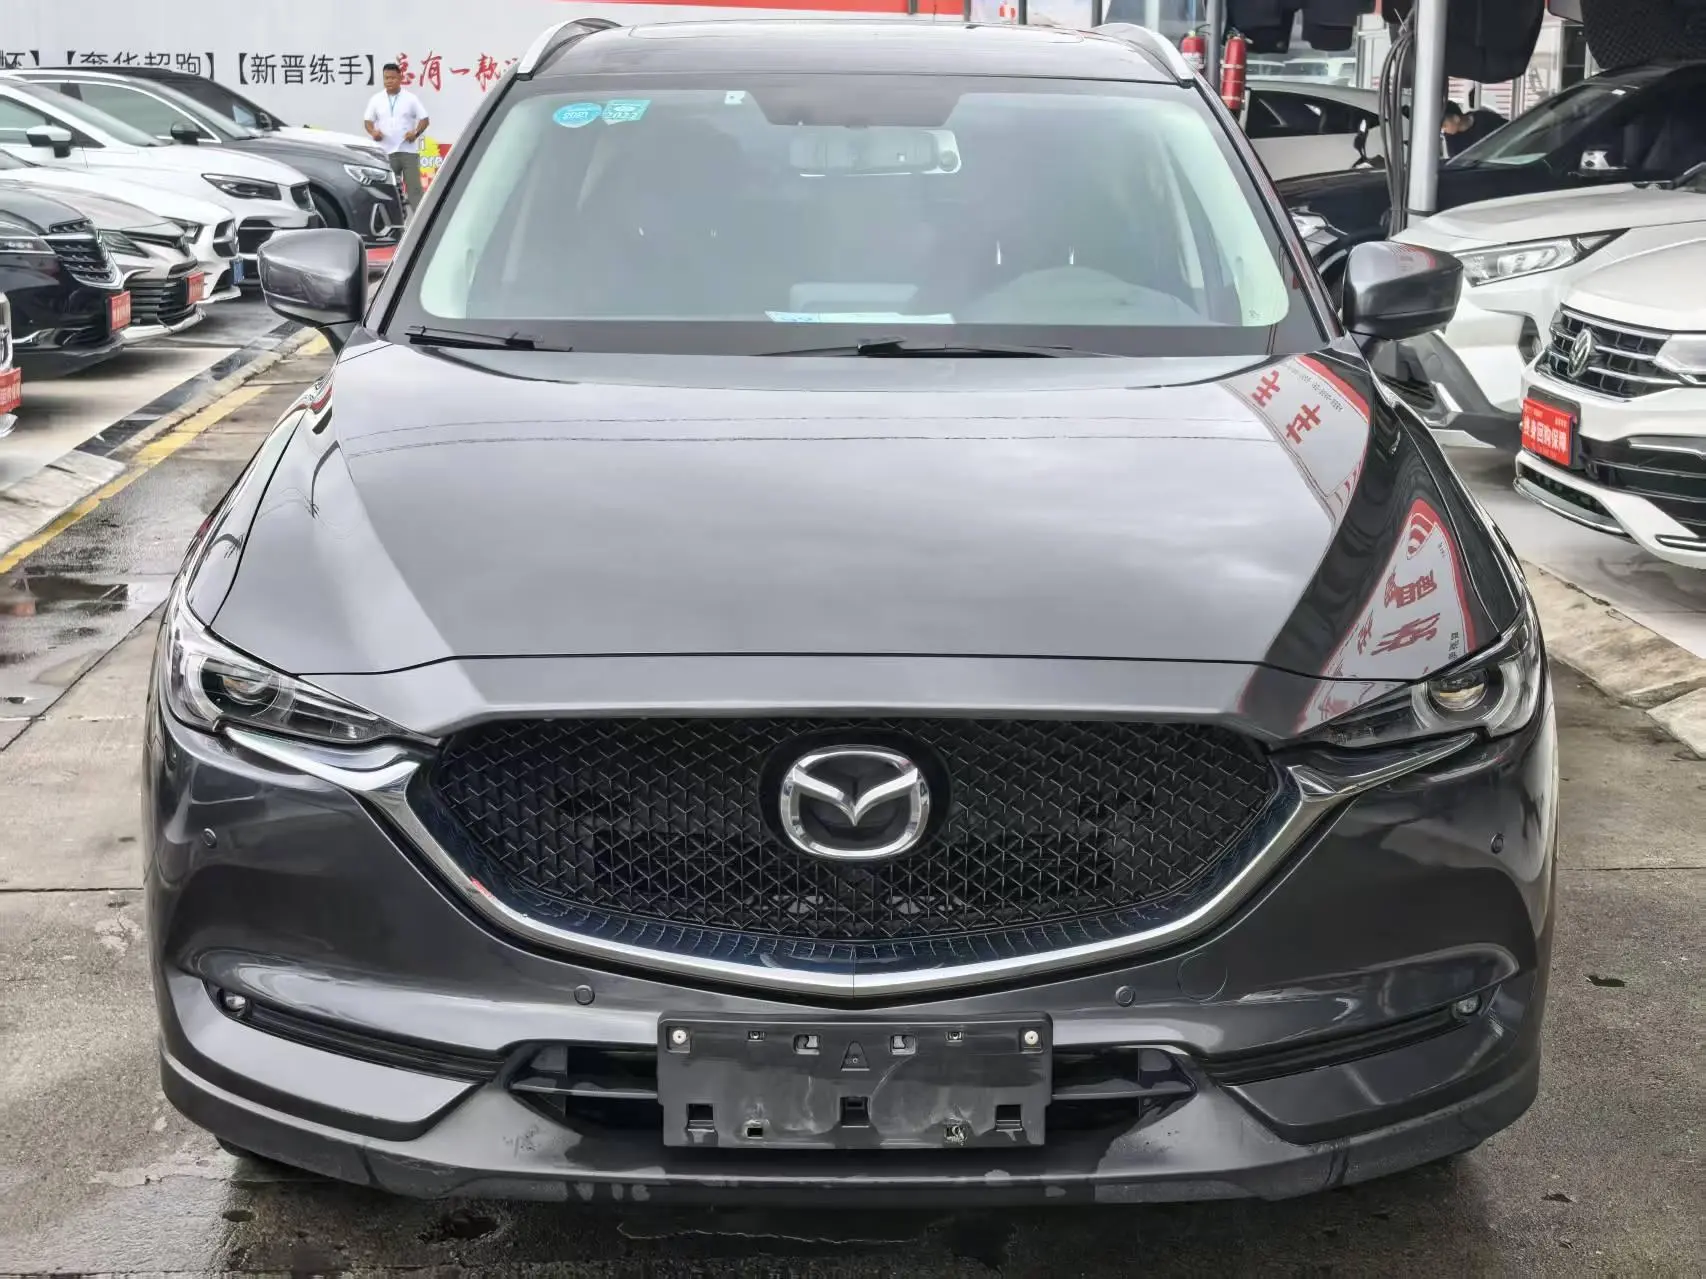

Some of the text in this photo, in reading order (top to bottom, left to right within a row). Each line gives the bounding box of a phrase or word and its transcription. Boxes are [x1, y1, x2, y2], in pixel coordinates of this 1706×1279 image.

[238, 52, 375, 85] 【新晋练手】
[396, 49, 518, 92] 总有一款
